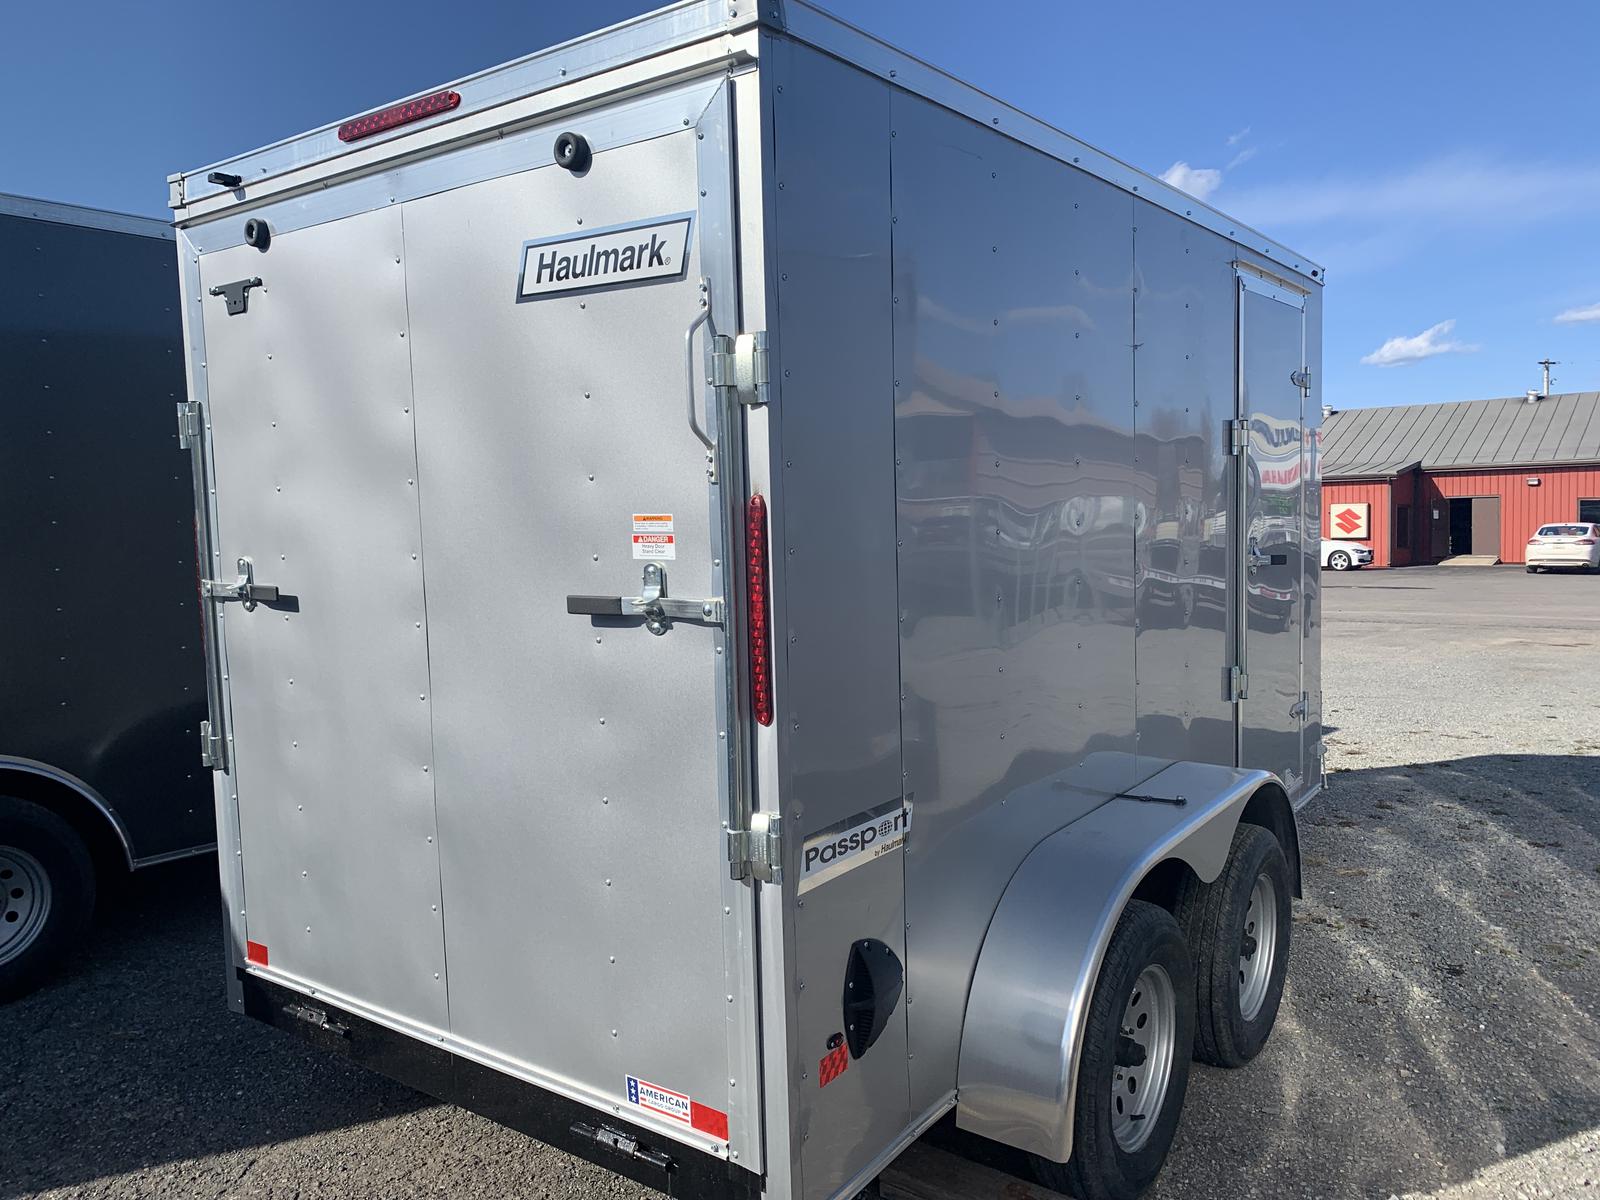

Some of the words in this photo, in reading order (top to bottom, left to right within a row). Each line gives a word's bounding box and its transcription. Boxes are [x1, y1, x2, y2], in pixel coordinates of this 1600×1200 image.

[535, 233, 668, 284] Haulmark
[639, 1087, 688, 1110] AMERICAN
[647, 1099, 664, 1109] CARGO
[664, 1104, 682, 1114] GROUP
